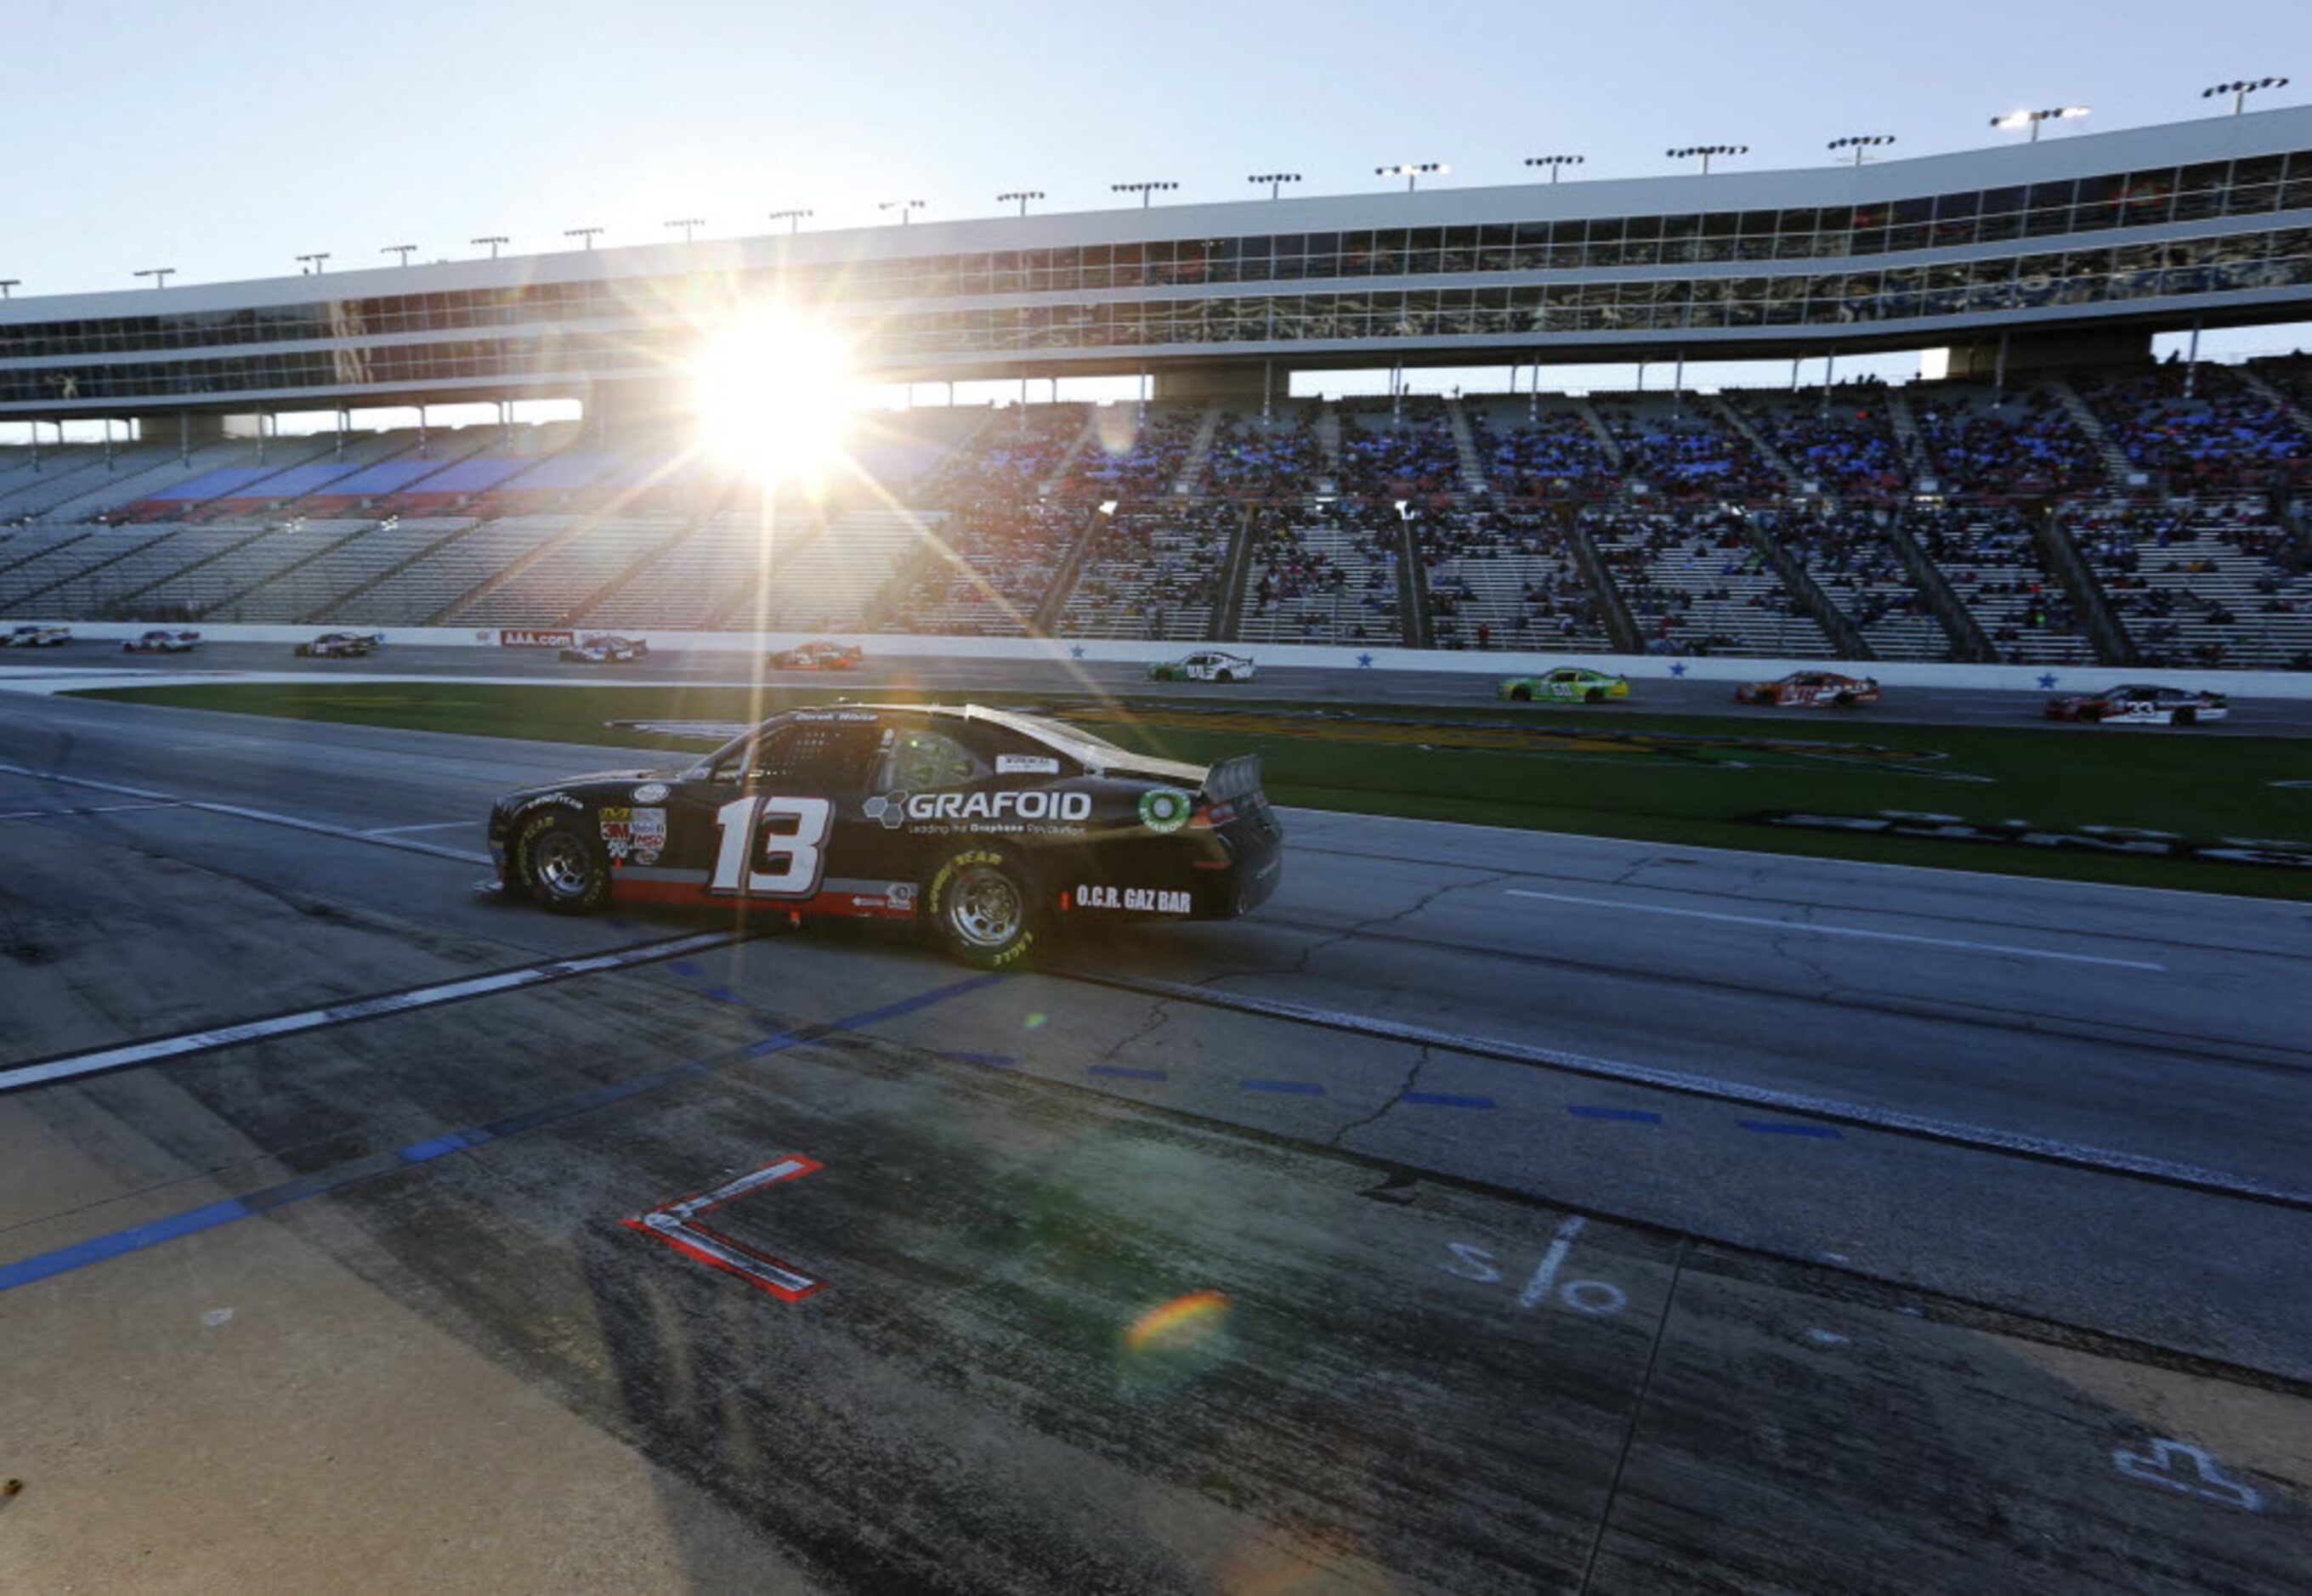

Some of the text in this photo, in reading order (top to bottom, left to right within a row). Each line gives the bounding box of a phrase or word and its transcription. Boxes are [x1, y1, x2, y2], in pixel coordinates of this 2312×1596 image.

[506, 631, 570, 645] AAA.com
[2126, 701, 2156, 716] 33
[908, 791, 1091, 821] GRAFOID
[602, 823, 629, 839] 3M
[909, 824, 949, 835] Leading
[971, 823, 1023, 834] Graphene
[710, 795, 835, 898] 13
[1076, 884, 1192, 914] O.C.R. GAZ BAR
